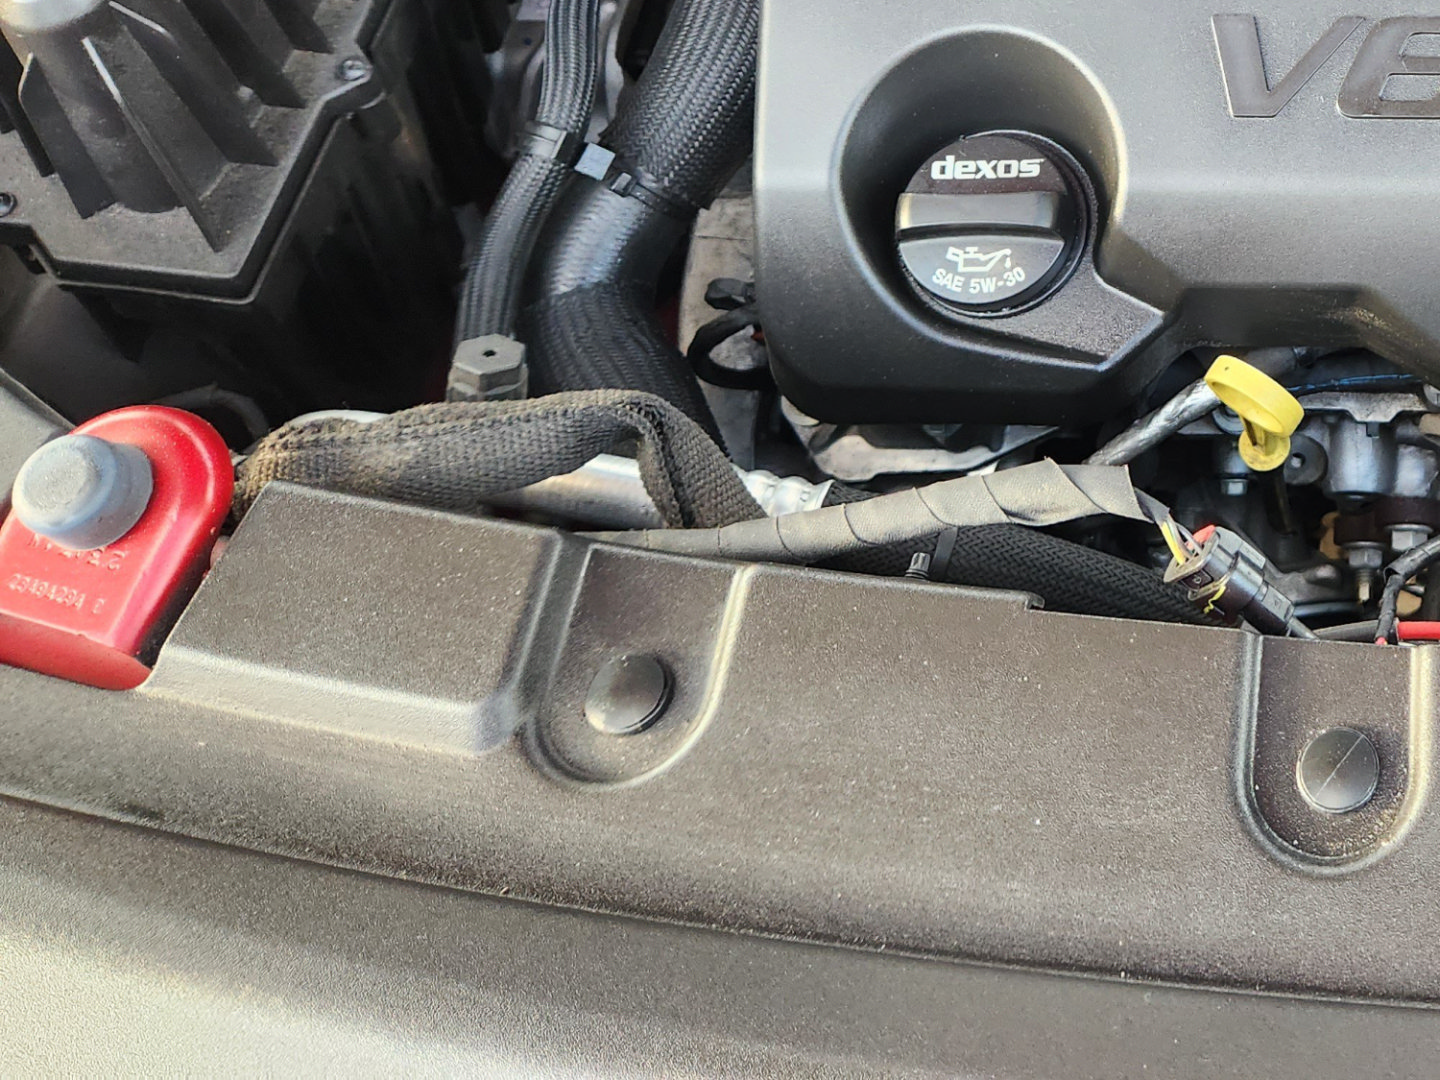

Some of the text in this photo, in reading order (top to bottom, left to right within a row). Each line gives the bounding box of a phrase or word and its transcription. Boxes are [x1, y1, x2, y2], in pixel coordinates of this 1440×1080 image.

[930, 154, 1046, 180] dexos
[932, 266, 1026, 294] SAE 5W-30
